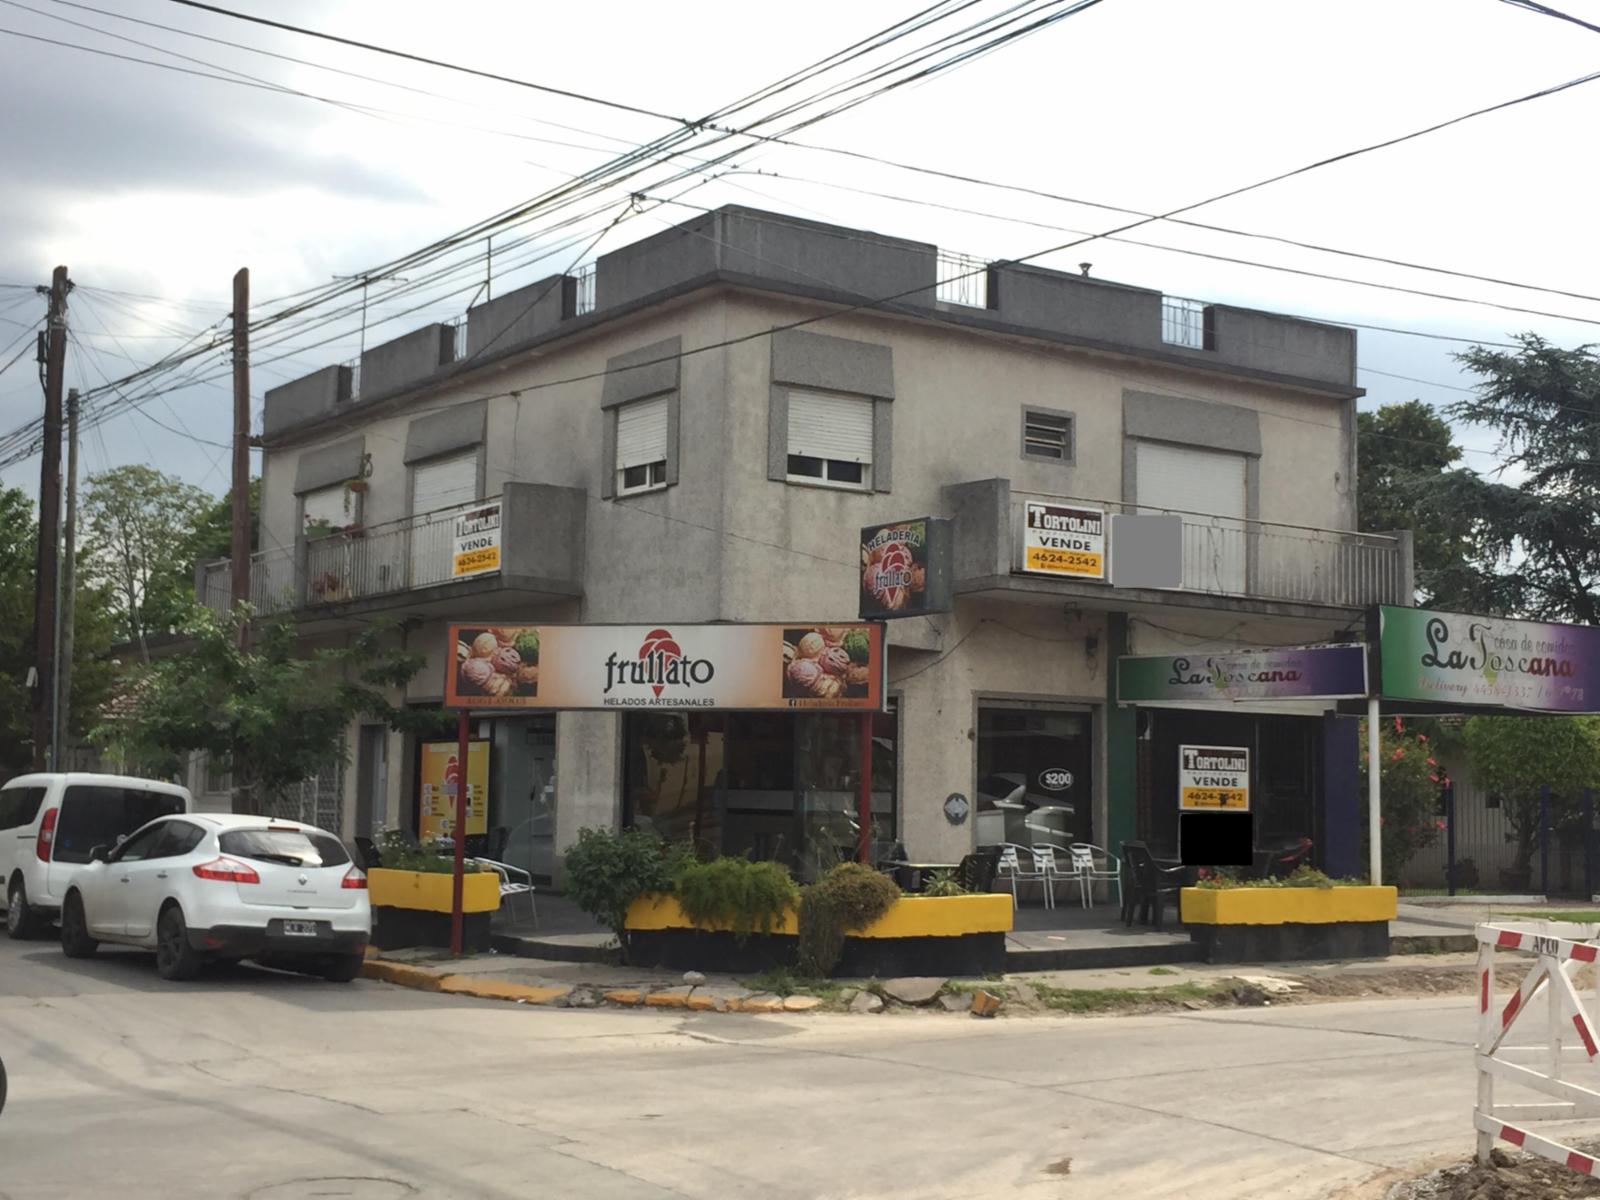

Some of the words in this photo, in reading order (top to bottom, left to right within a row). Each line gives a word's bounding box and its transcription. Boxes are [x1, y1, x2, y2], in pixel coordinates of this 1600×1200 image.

[1029, 506, 1101, 534] TORTOLINI
[461, 537, 493, 551] VENDE
[1039, 536, 1092, 551] VENDE
[1033, 553, 1097, 567] 4624-2542
[1421, 617, 1469, 670] La
[1469, 623, 1577, 677] Toscana
[604, 652, 715, 693] frullato
[1169, 658, 1205, 685] La
[604, 697, 647, 706] HELADOS
[648, 697, 715, 707] ARTESANALES
[1184, 749, 1246, 770] TORTOLINI
[1193, 776, 1239, 787] VENDE
